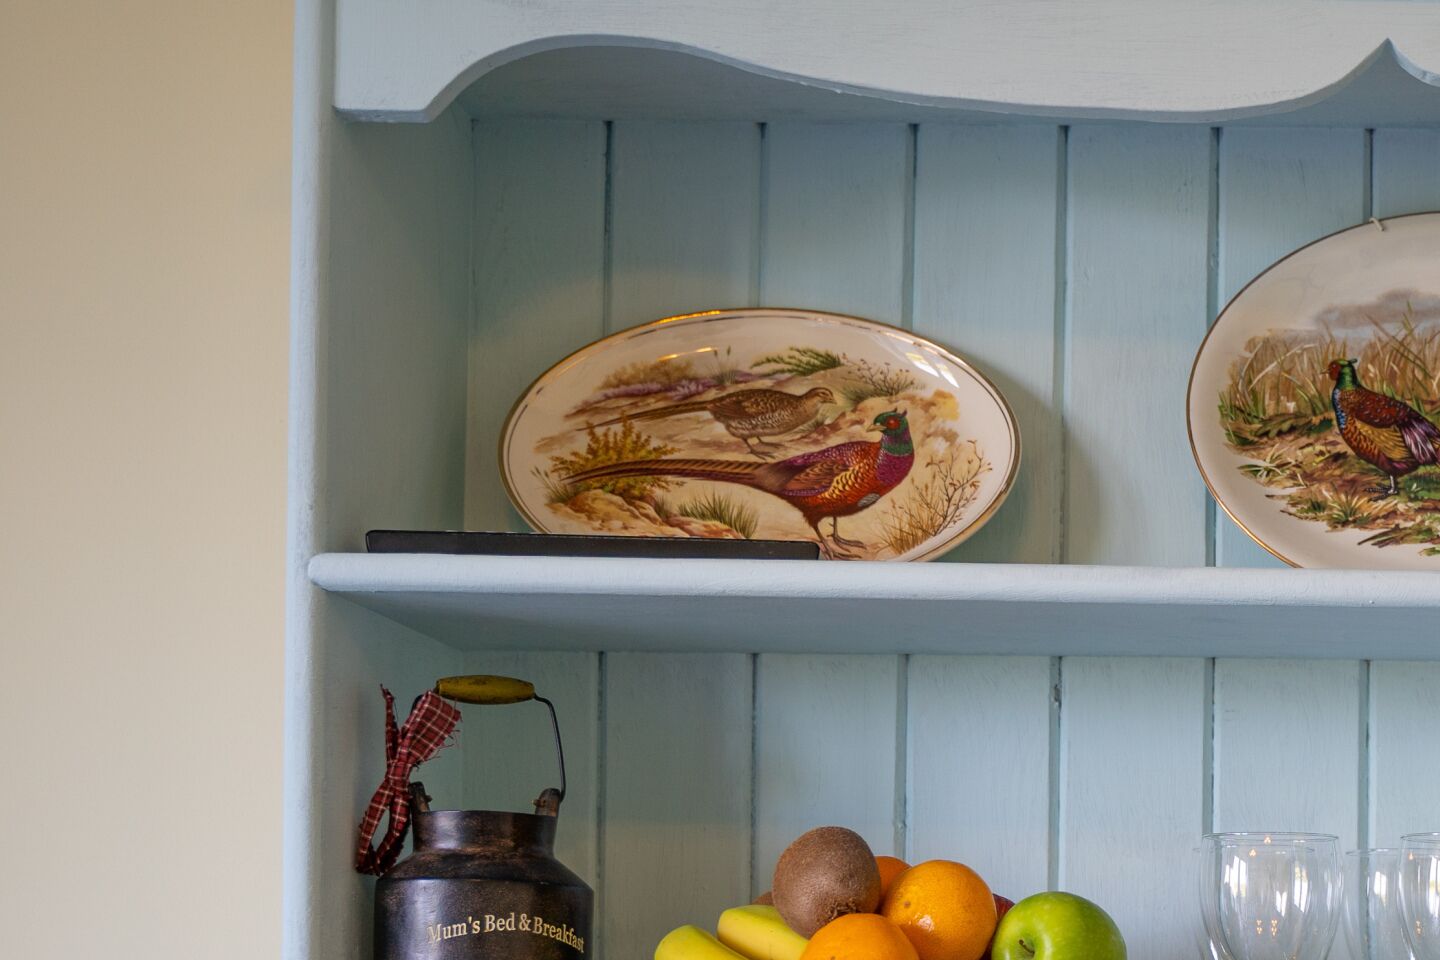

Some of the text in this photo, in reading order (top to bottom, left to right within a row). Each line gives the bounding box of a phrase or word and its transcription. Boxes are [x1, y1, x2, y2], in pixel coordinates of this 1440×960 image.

[427, 912, 585, 954] Mum's Bed & Breakfast
